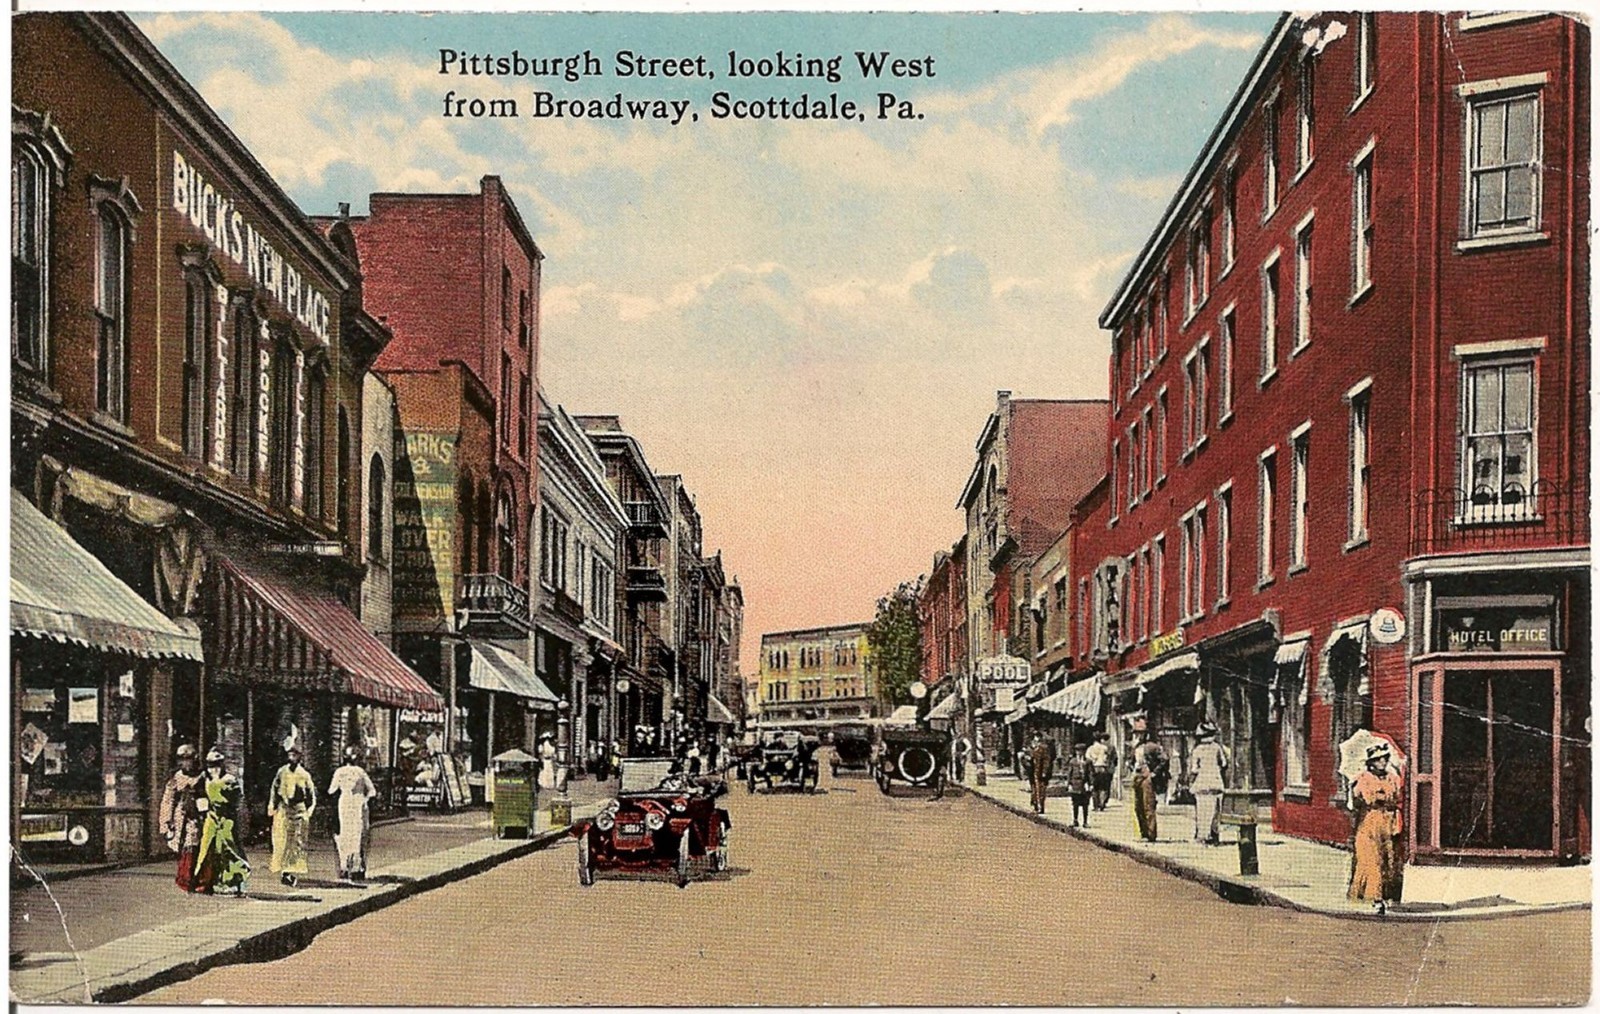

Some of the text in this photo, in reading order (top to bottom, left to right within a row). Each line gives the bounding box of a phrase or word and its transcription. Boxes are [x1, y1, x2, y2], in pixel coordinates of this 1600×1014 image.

[173, 150, 331, 346] BUCK'S NEW PLACE
[214, 284, 228, 462] BILLIARDS
[258, 349, 270, 472] POCKET
[401, 528, 451, 549] OVER
[1450, 628, 1547, 643] HOTEL OFFICE
[981, 665, 1028, 680] POOL
